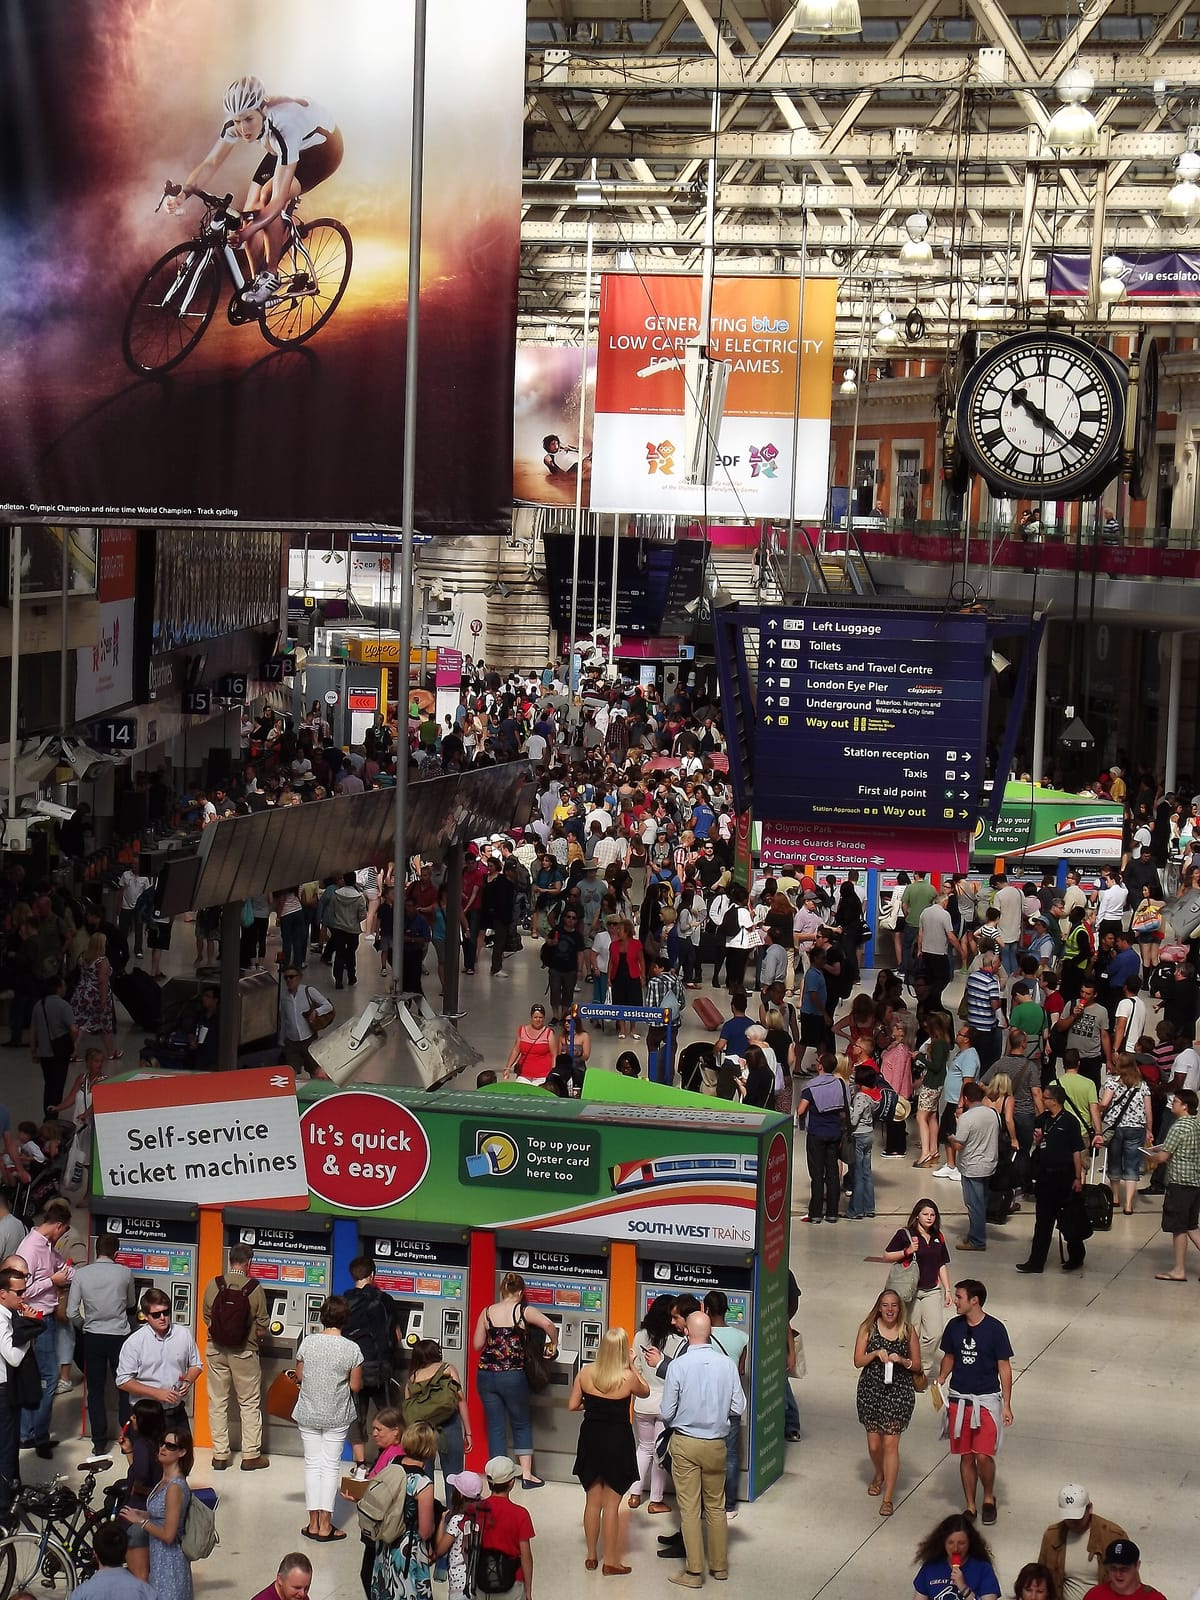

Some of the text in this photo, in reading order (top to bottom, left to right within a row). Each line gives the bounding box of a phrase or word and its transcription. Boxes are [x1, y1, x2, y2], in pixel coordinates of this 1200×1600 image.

[1139, 272, 1154, 281] via
[644, 316, 790, 333] GENERTING blue
[609, 335, 648, 350] LOW
[725, 338, 824, 355] ELECTRICITY
[29, 503, 56, 513] Olympic
[57, 504, 90, 514] Champion
[91, 505, 104, 513] and
[105, 505, 120, 514] nine
[121, 506, 136, 514] time
[137, 506, 157, 515] World
[158, 507, 192, 516] Champion
[197, 508, 214, 516] Track
[215, 508, 239, 518] cycling
[812, 620, 882, 636] Left Luggage
[808, 640, 842, 652] Toilets
[265, 664, 280, 679] 17
[808, 660, 934, 676] Tickets and Travel Centre
[227, 679, 244, 694] 16
[806, 679, 888, 693] London Eye Pier
[189, 694, 207, 709] 15
[806, 698, 872, 711] Underground
[908, 708, 920, 716] City
[806, 717, 849, 730] Way out
[107, 724, 130, 744] 14
[843, 747, 930, 762] Station reception
[903, 768, 928, 780] Taxis
[858, 785, 927, 800] First aid point
[812, 805, 926, 818] Station Approach Way out
[1005, 817, 1013, 826] up
[1014, 817, 1030, 826] your
[776, 823, 812, 834] Olympic
[814, 825, 832, 833] Park
[1014, 825, 1030, 834] card
[775, 838, 866, 850] Horse Guards Parade
[988, 835, 1019, 843] here too
[773, 851, 868, 864] Charing Cross Station
[1063, 847, 1083, 855] SOUTH
[580, 1006, 663, 1019] Customer assistance
[127, 1119, 269, 1151] Self-service
[309, 1123, 411, 1154] It's quick
[527, 1136, 591, 1153] Top up your
[526, 1152, 590, 1168] Oyster card
[108, 1152, 297, 1187] ticket machines
[322, 1154, 397, 1186] & easy
[526, 1167, 573, 1181] here too
[126, 1217, 161, 1229] TICKETS
[628, 1220, 673, 1236] SOUTH
[675, 1223, 711, 1239] WEST
[125, 1228, 167, 1238] Card Payments
[259, 1229, 295, 1240] TICKETS
[298, 1243, 327, 1251] Payments
[395, 1240, 431, 1251] TICKETS
[408, 1252, 437, 1260] Payments
[533, 1252, 570, 1263] TICKETS
[574, 1266, 603, 1275] Payments
[675, 1263, 713, 1275] TICKETS
[674, 1274, 719, 1284] Card Payments
